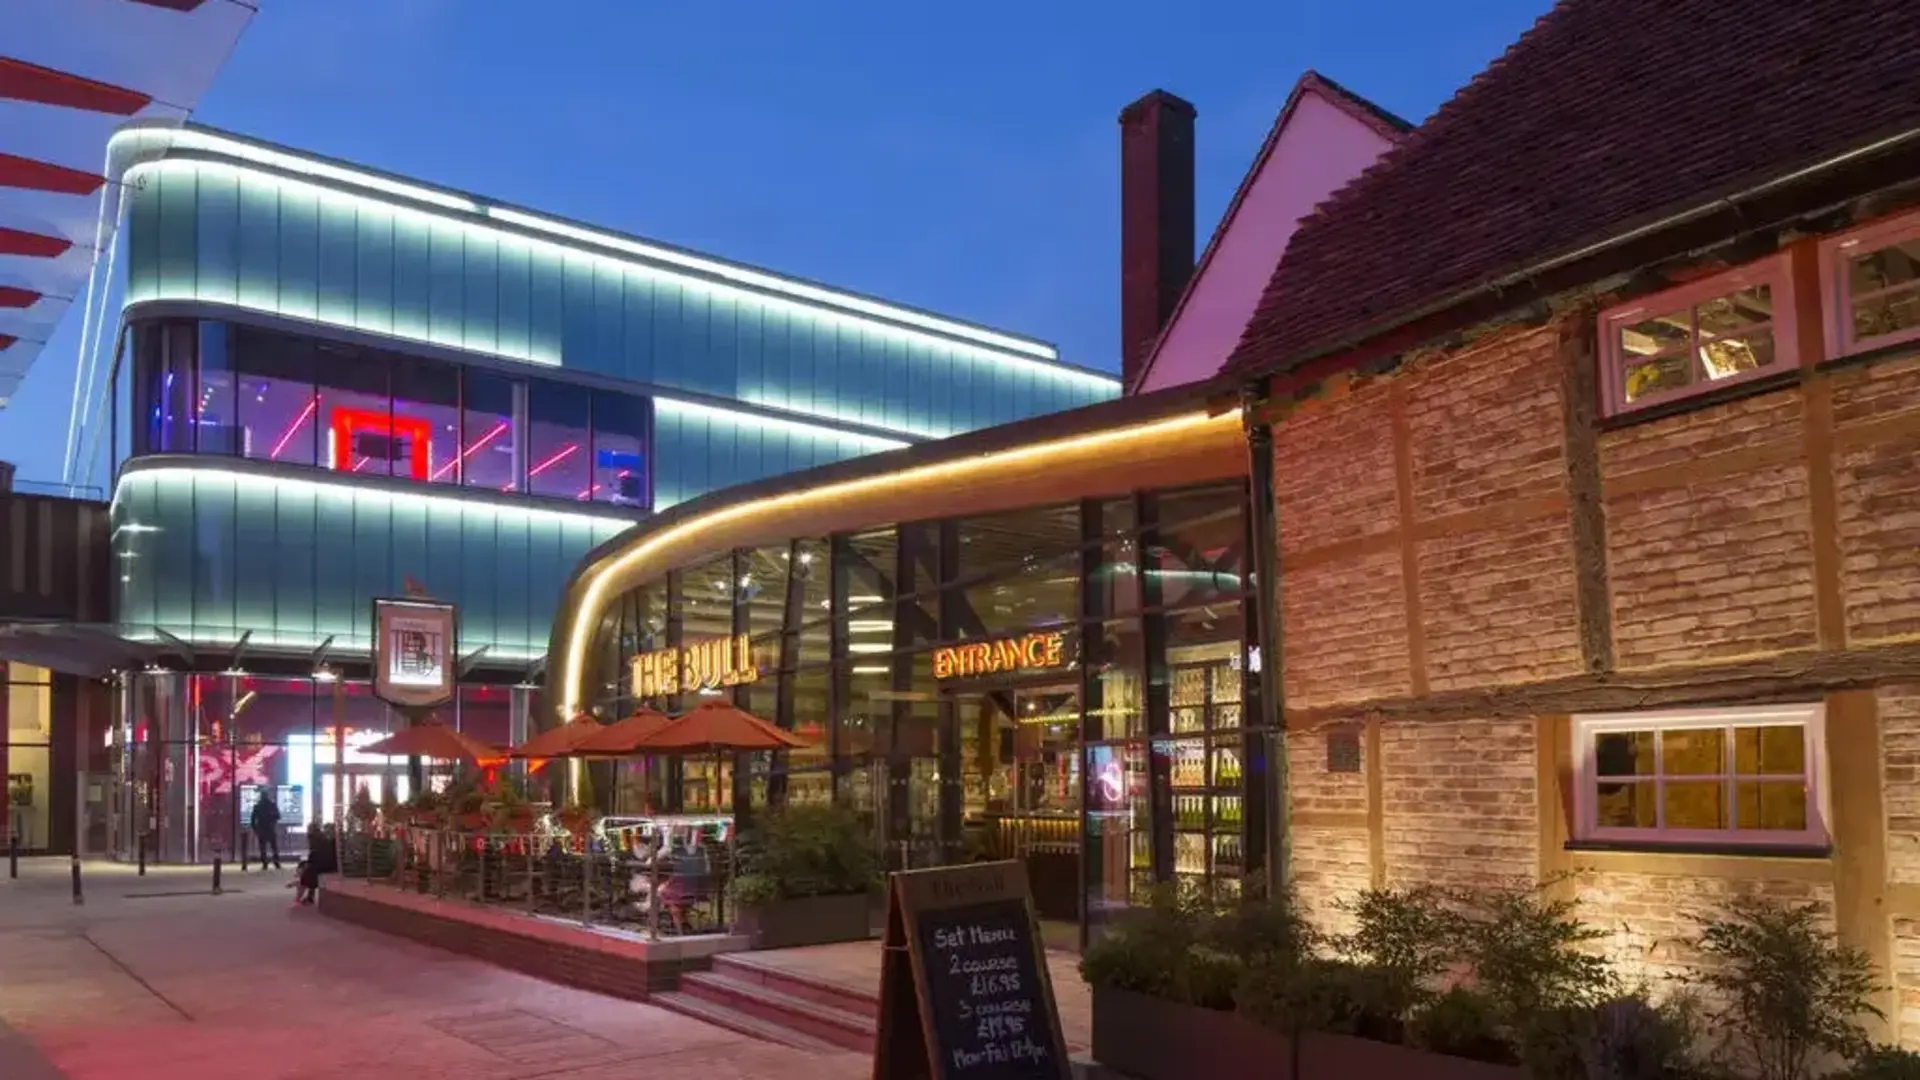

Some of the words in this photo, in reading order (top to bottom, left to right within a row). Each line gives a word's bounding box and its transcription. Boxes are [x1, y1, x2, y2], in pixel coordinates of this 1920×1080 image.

[631, 650, 678, 698] THE
[684, 634, 758, 691] BULL
[932, 632, 1064, 678] ENTRANCE
[934, 926, 964, 948] Set
[971, 973, 1021, 995] £16.95
